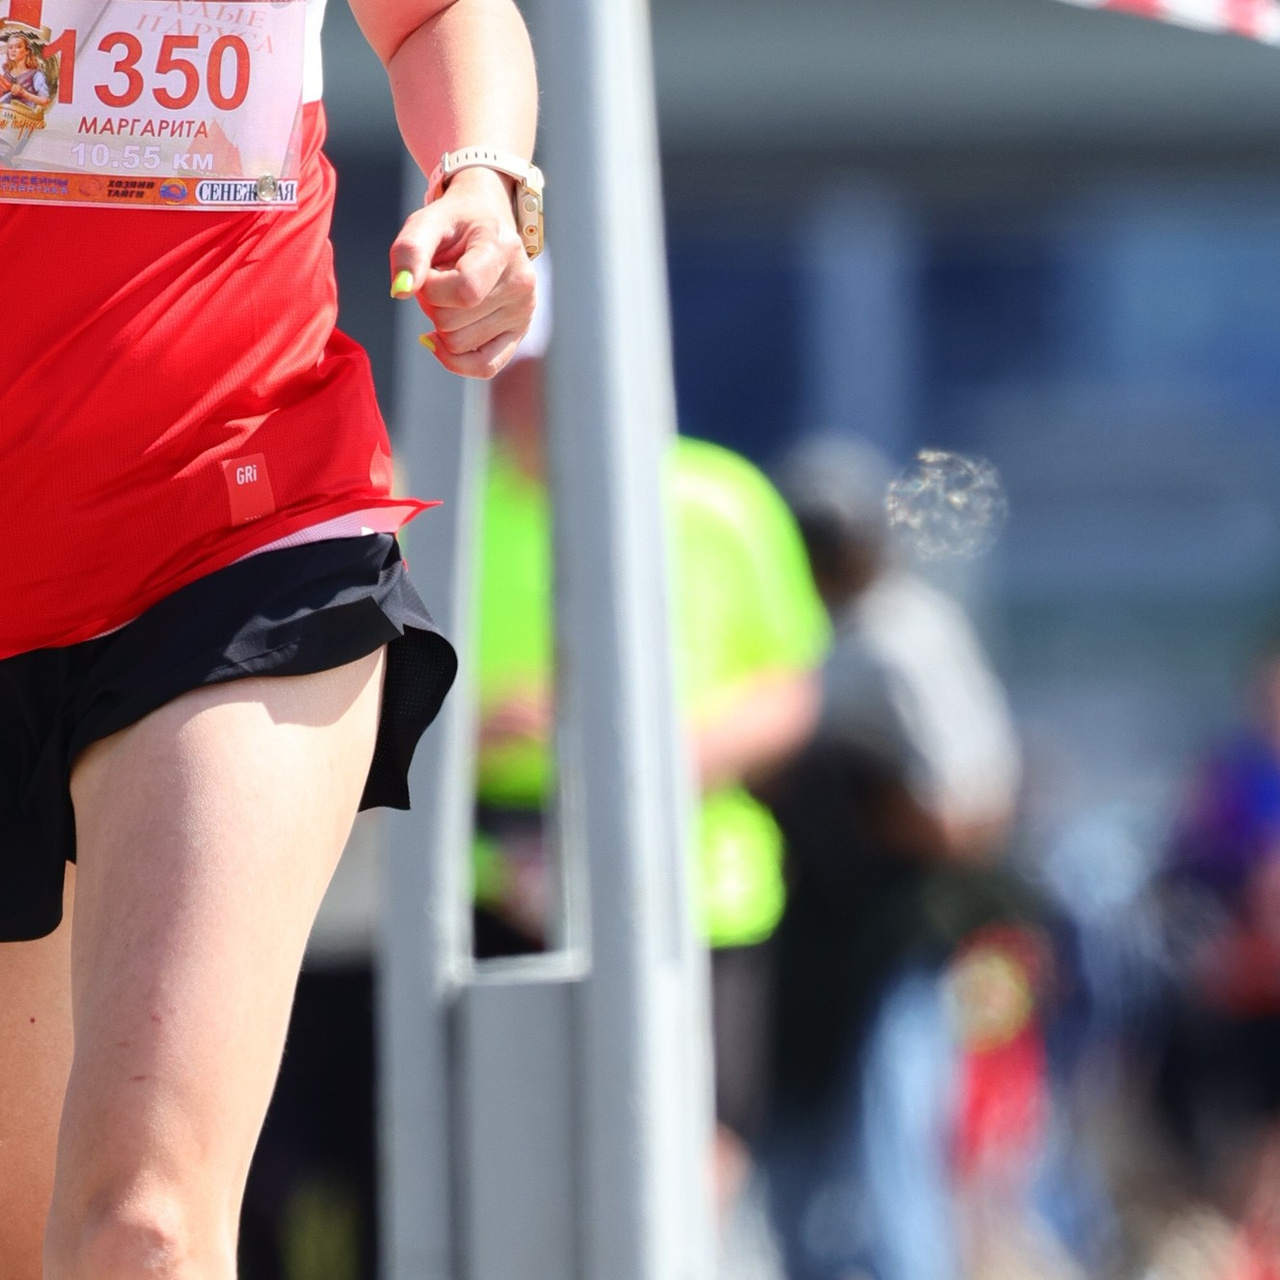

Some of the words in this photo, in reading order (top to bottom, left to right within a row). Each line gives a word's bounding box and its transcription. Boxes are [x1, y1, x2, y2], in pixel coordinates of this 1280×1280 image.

[43, 28, 251, 111] 1350
[78, 116, 208, 138] МАРГАРИТА
[71, 142, 161, 170] 10.55
[199, 182, 295, 201] СЕНЕЖАЯ
